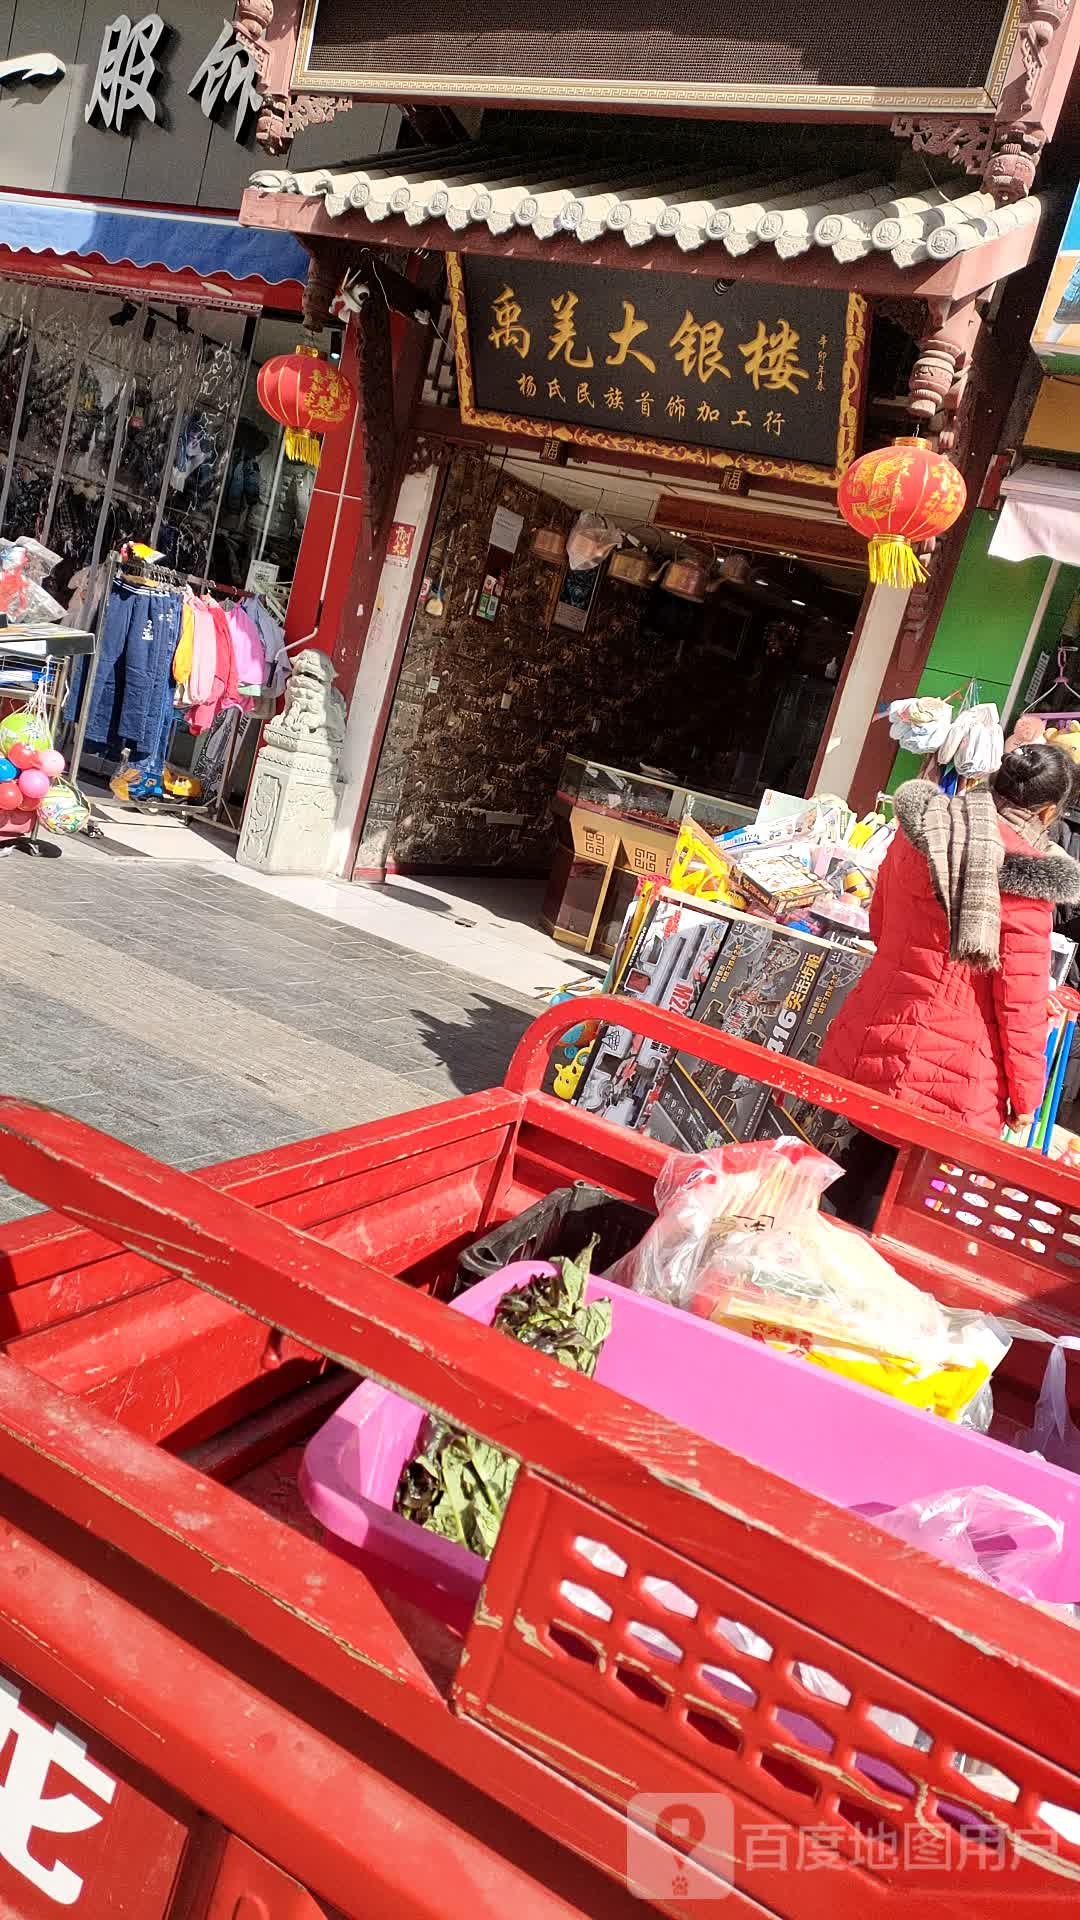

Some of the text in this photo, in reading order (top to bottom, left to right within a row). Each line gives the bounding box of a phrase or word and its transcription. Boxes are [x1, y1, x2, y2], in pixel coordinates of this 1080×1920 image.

[516, 374, 789, 438] 杨氏民族首饰加工行
[721, 468, 743, 491] 福
